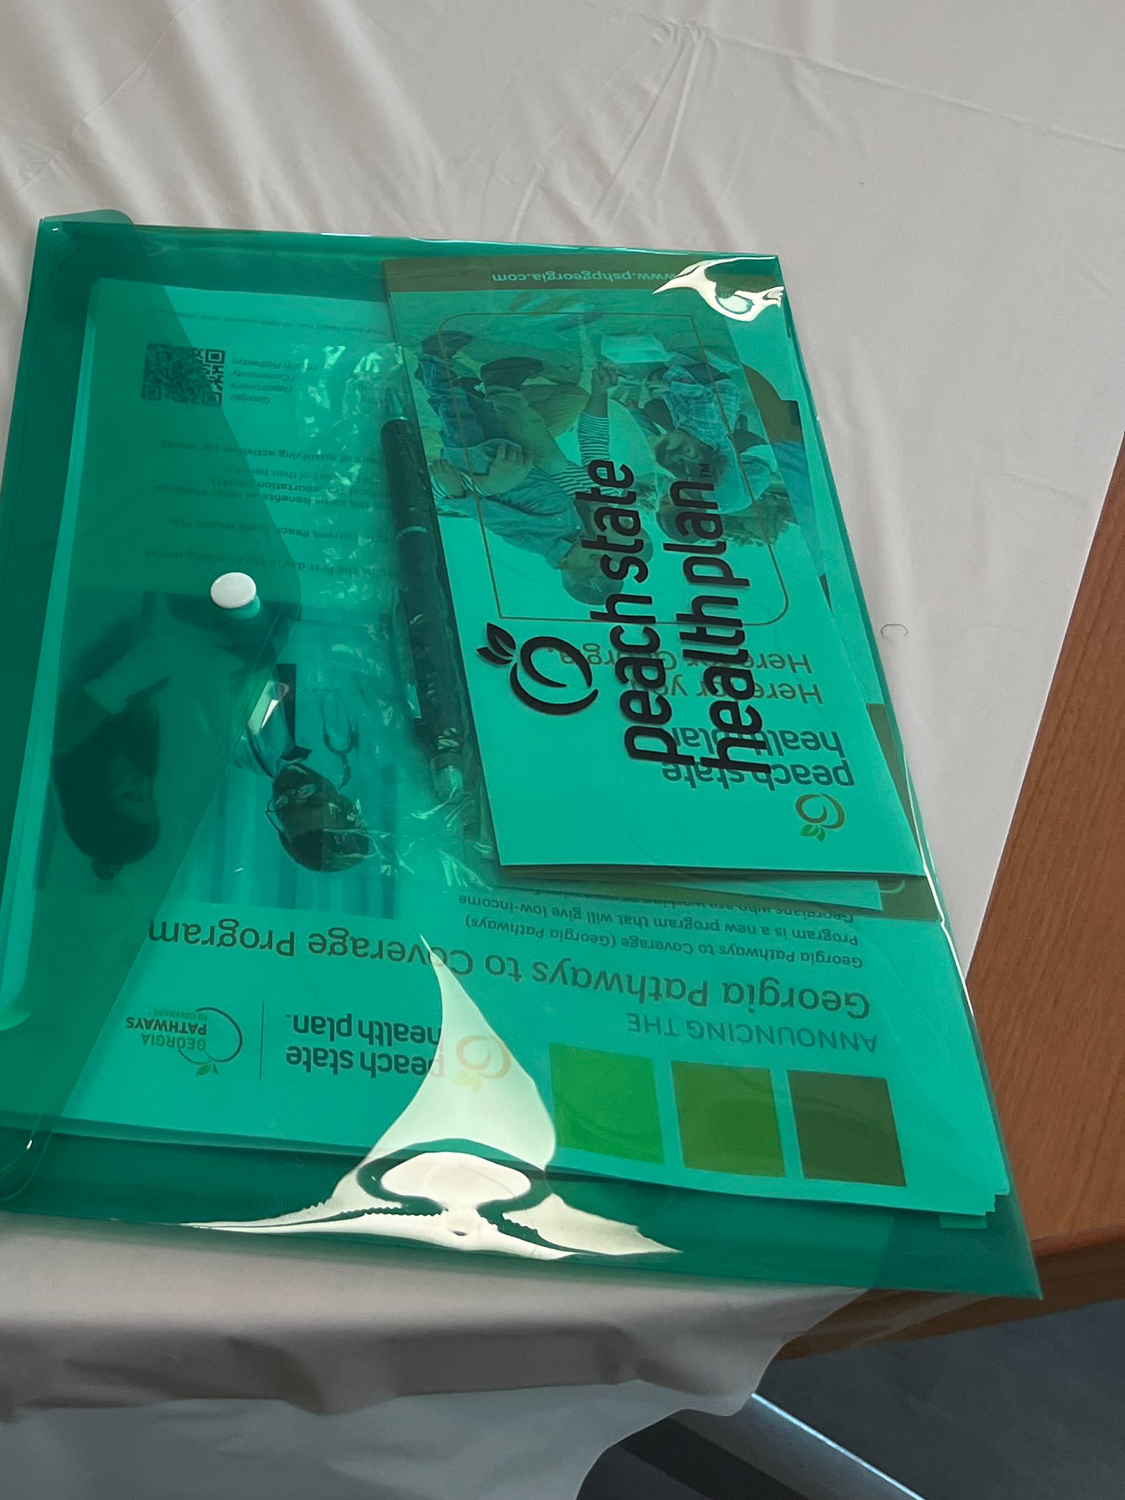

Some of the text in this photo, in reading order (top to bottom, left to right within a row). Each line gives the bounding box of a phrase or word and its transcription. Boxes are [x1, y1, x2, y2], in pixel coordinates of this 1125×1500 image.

[277, 449, 337, 463] qualifying
[262, 493, 312, 507] benefits
[663, 480, 750, 587] plan
[575, 459, 695, 766] peach state
[676, 594, 771, 774] health
[458, 895, 547, 919] low-income
[551, 906, 582, 922] give
[585, 910, 613, 926] will
[616, 914, 649, 930] that
[647, 916, 720, 934] program
[724, 923, 757, 936] new
[760, 925, 771, 936] a
[774, 926, 787, 939] is
[791, 928, 859, 947] Program
[464, 914, 863, 969] Georgia Pathways to Coverage (Georgia Pathways)
[148, 918, 871, 1020] Georgia Pathways to Coverage Program
[125, 1016, 208, 1037] PATHWAYS
[292, 1013, 352, 1043] plan
[626, 1012, 878, 1053] ANNOUNCING THE
[140, 1032, 207, 1052] GEORGIA
[285, 1045, 355, 1075] state
